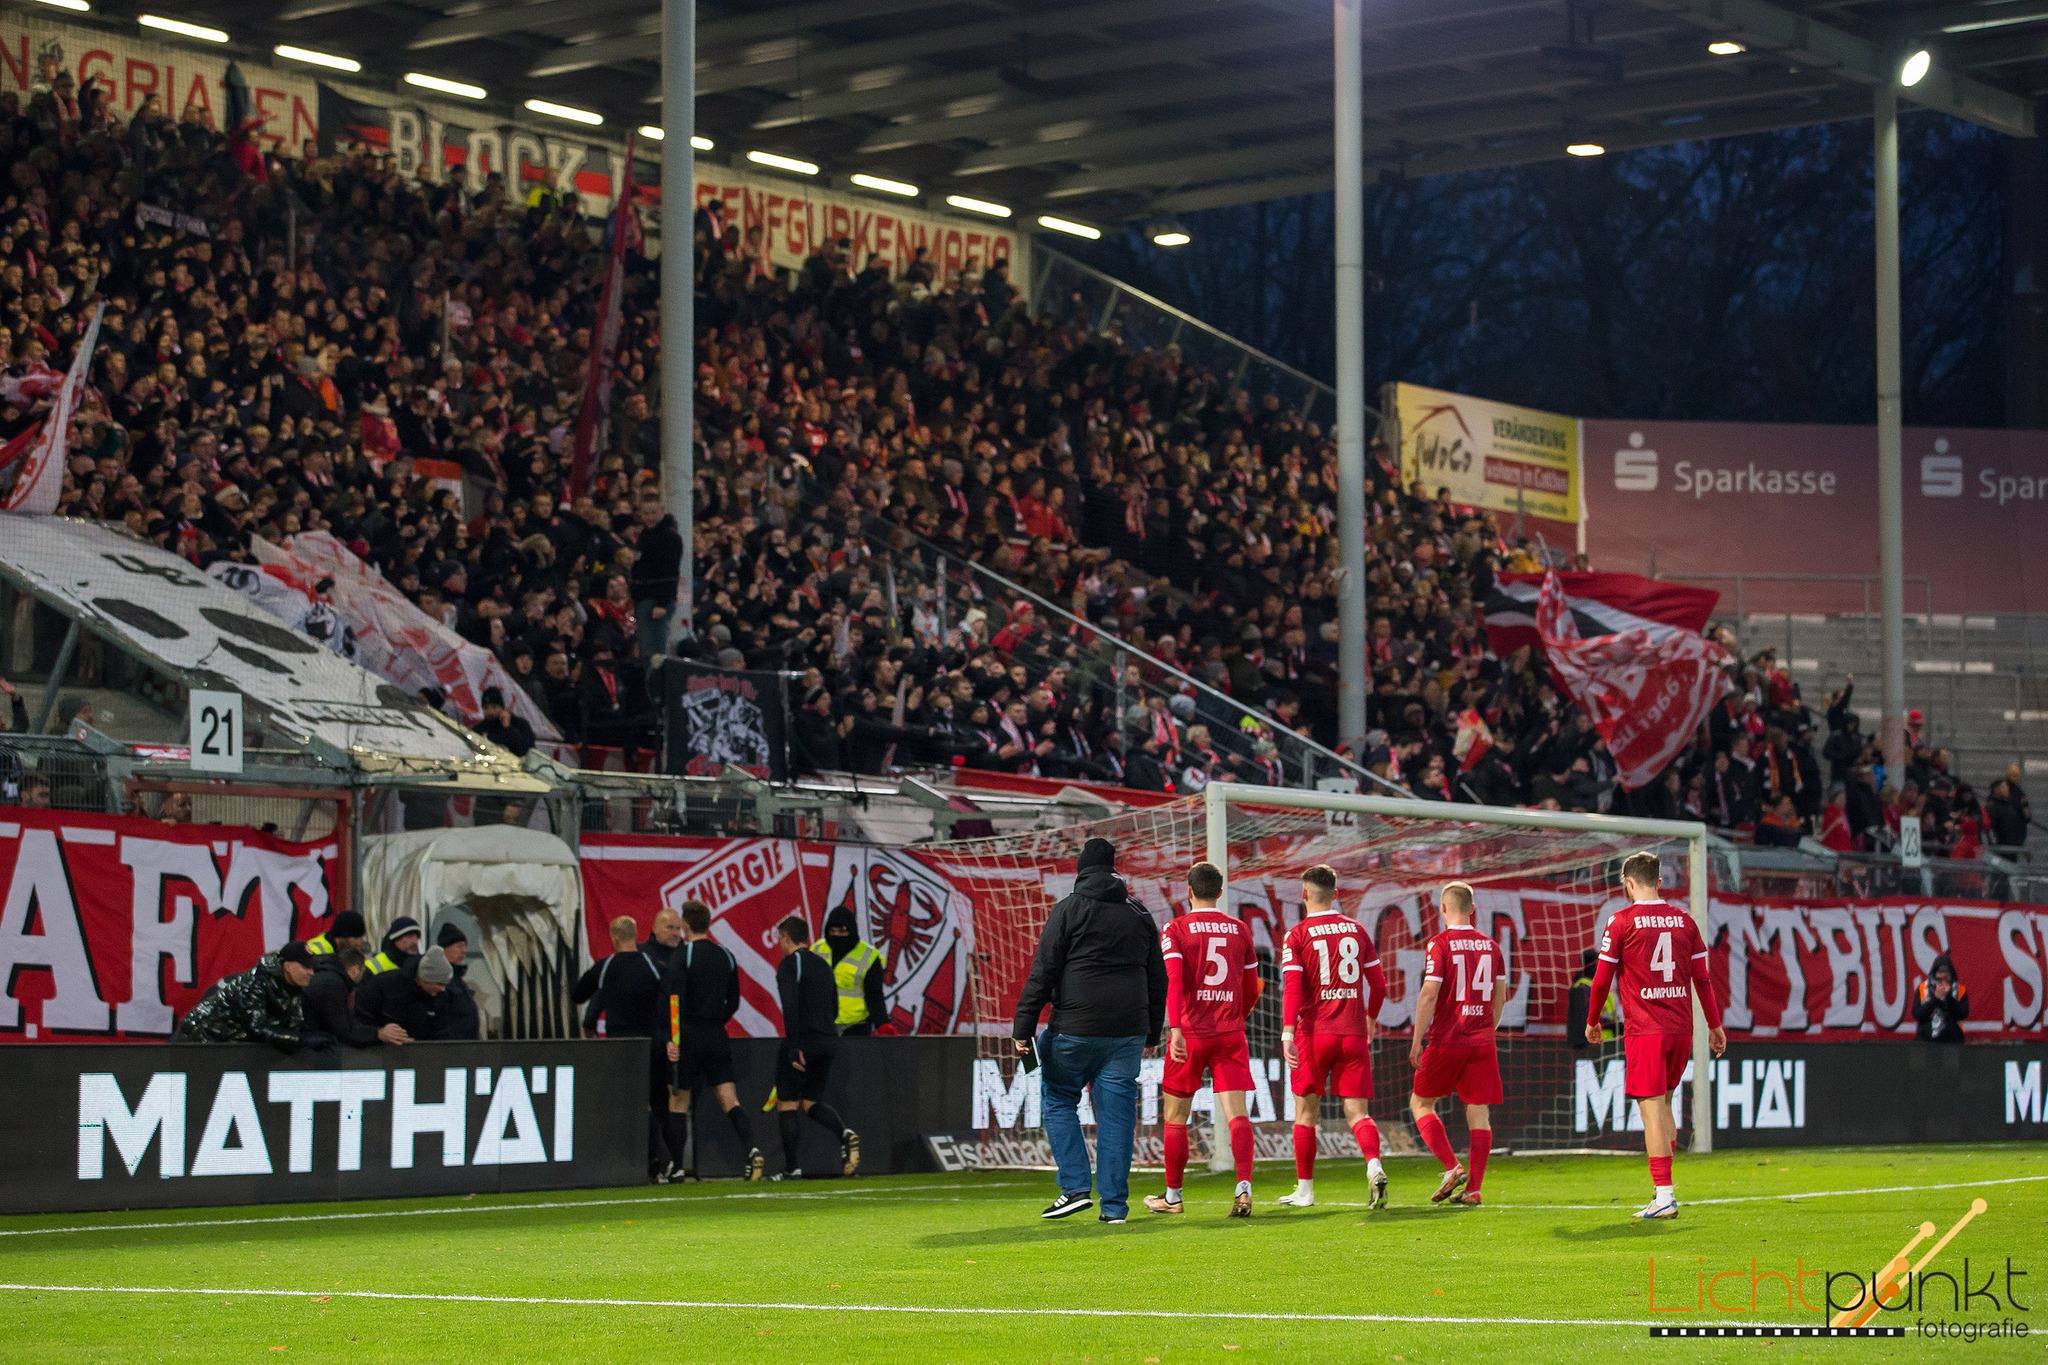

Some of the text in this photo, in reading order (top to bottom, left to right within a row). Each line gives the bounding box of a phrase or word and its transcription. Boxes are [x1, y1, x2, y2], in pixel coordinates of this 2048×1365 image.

[1673, 460, 1836, 500] Sparkasse
[200, 705, 234, 757] 21
[1904, 826, 1919, 858] 23
[1188, 922, 1239, 935] ENERGIE
[1308, 922, 1358, 938] ENERGIE
[1634, 916, 1685, 929] ENERGIE
[1203, 937, 1229, 986] 5
[1313, 936, 1360, 986] 18
[1449, 939, 1493, 952] ENERGIE
[1650, 931, 1676, 983] 4
[1452, 954, 1494, 1002] 14
[1998, 909, 2048, 1030] S
[1197, 989, 1234, 1002] PELIVAN
[1640, 986, 1687, 1000] CAMPULKA
[2004, 1060, 2048, 1125] M
[77, 1065, 574, 1180] MATTHÄI
[928, 1132, 1058, 1172] Eisenbac
